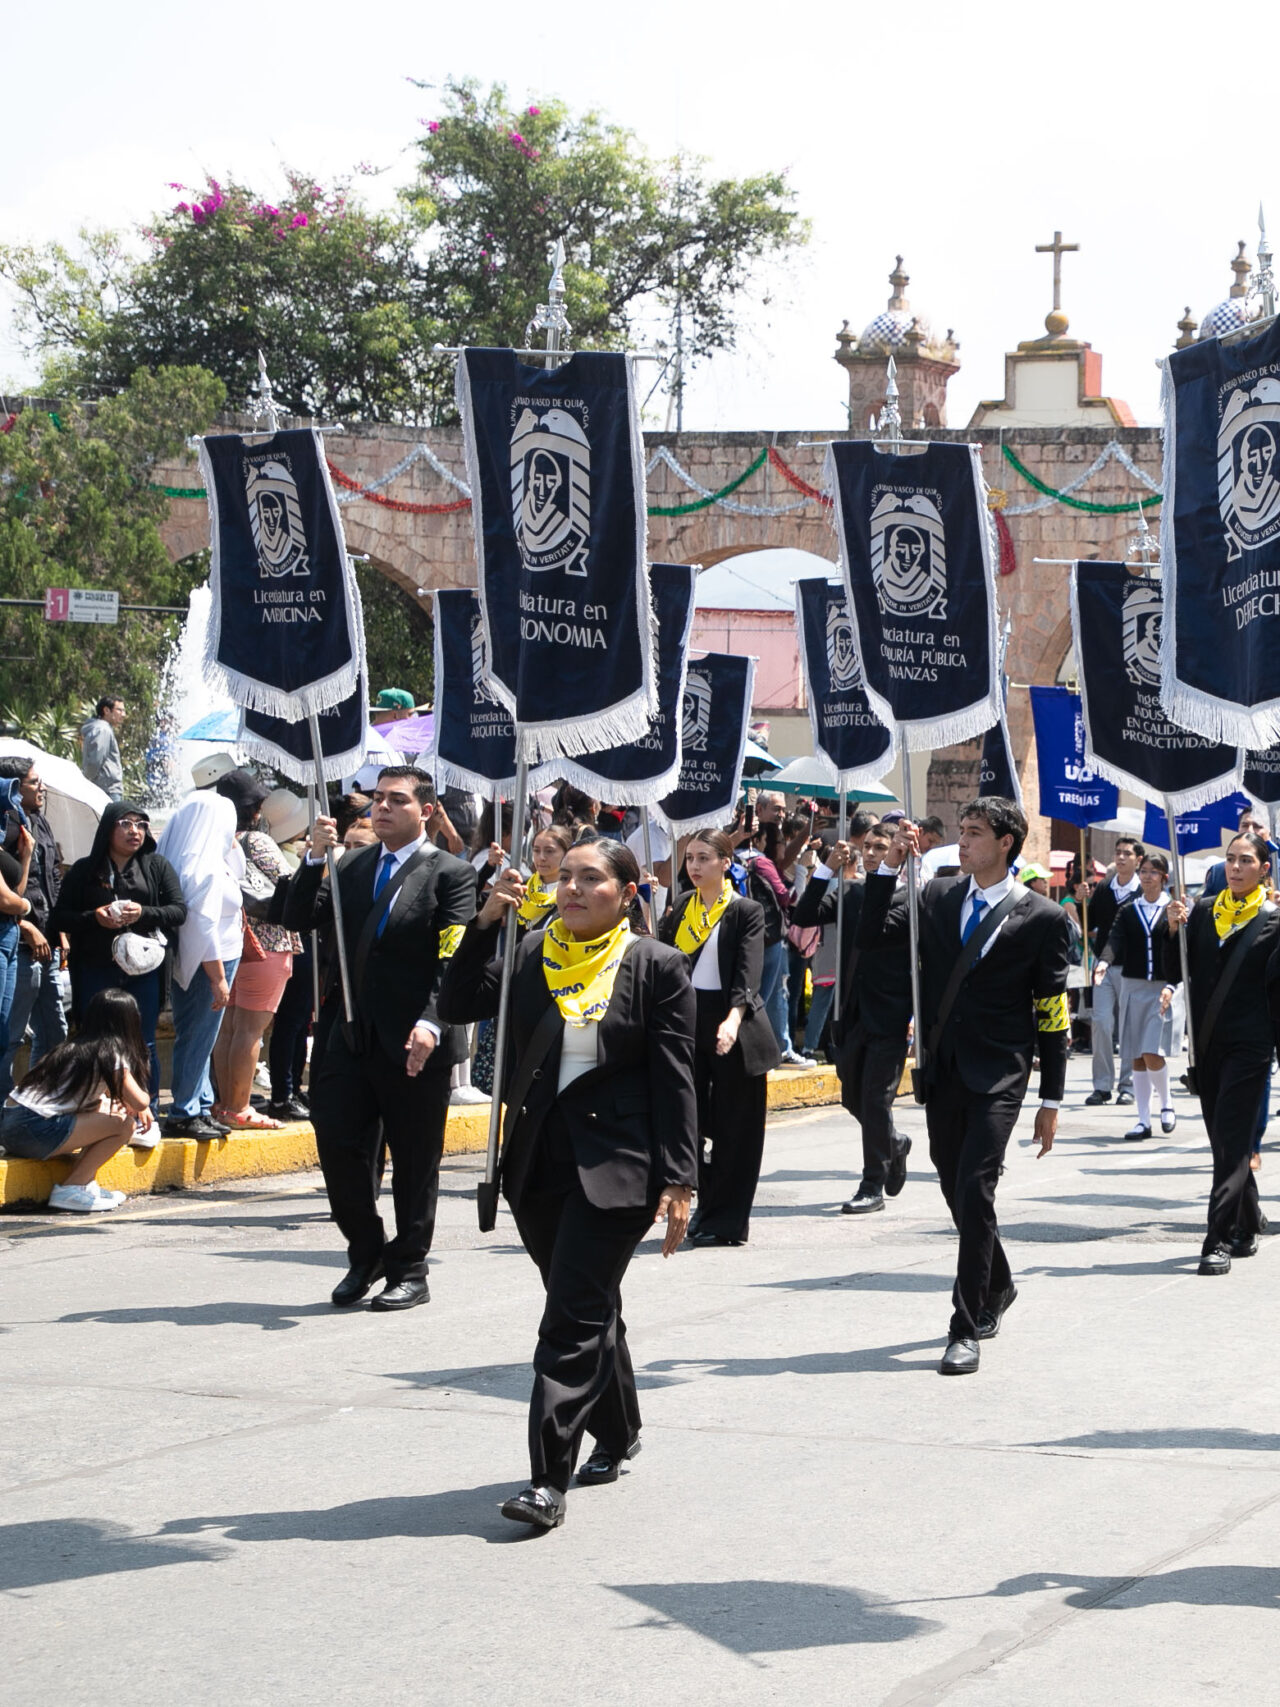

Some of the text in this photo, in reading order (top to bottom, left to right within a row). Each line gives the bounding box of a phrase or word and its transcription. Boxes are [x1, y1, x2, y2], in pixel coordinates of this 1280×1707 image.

[1259, 366, 1269, 377] DE
[552, 398, 562, 408] DE
[539, 539, 575, 564] VERITATE
[309, 589, 326, 602] en
[899, 603, 906, 611] IN
[908, 592, 936, 611] VERITATE
[56, 595, 64, 614] 1
[583, 604, 608, 620] en
[943, 634, 960, 648] en
[921, 648, 967, 668] PÚBLICA
[1126, 716, 1141, 729] EN
[1121, 729, 1219, 749] PRODUCTIVIDAD
[703, 760, 717, 770] en
